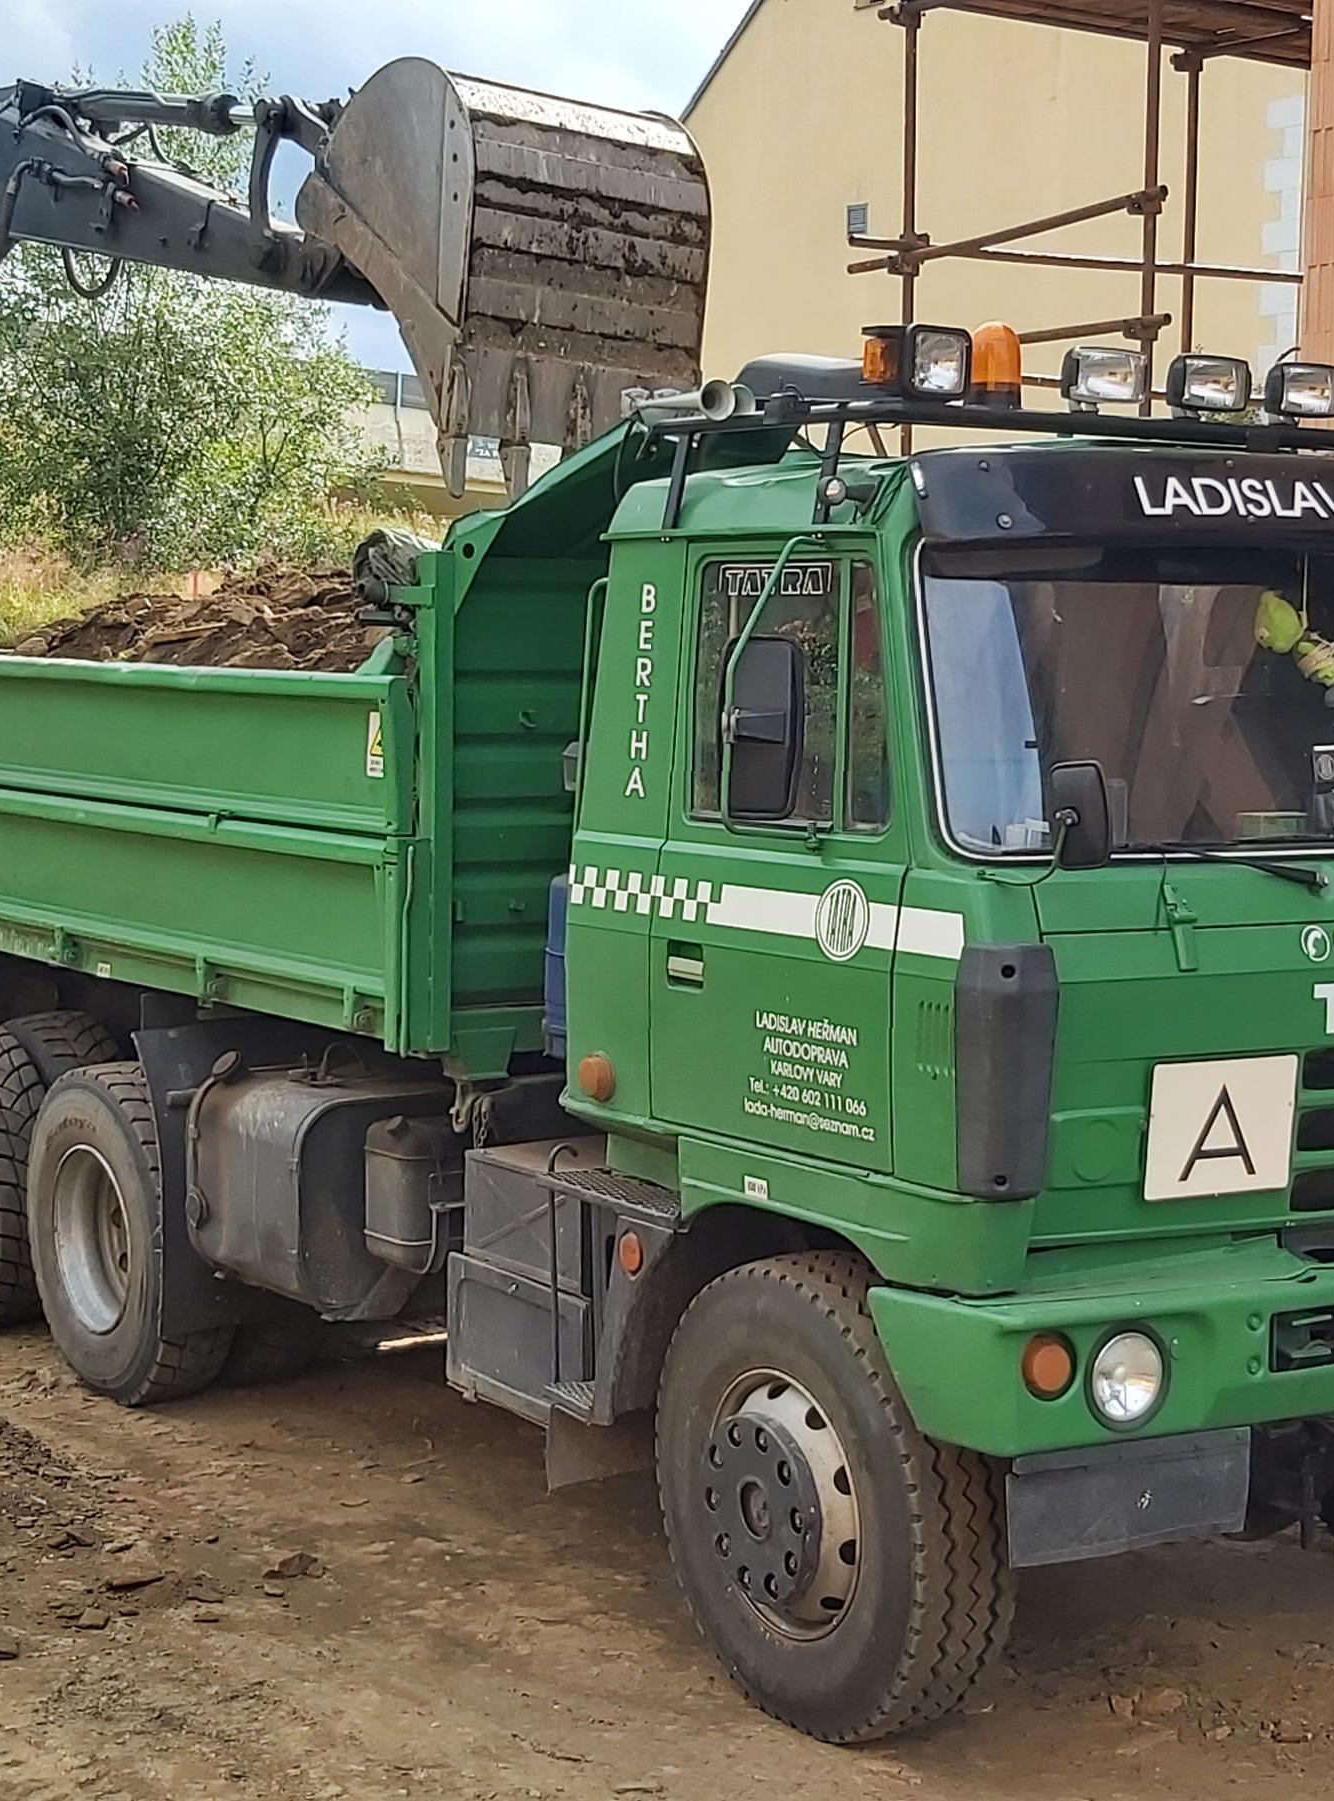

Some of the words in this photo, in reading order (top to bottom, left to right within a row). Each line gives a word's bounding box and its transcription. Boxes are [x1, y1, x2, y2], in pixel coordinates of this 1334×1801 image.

[624, 583, 657, 798] BERTHA
[755, 1009, 807, 1037] LADISLAV
[807, 1018, 858, 1047] HEŘMAN
[763, 1036, 850, 1069] AUTODOPRAVA
[770, 1059, 815, 1083] KARLOVY
[815, 1068, 843, 1089] VARY
[749, 1077, 770, 1095] Tel.:
[772, 1084, 800, 1102] +420
[801, 1088, 822, 1106] 602
[824, 1092, 843, 1112] 111
[845, 1097, 867, 1117] 066
[744, 1096, 876, 1142] lada-herman@seznam.cz
[1177, 1082, 1257, 1182] A
